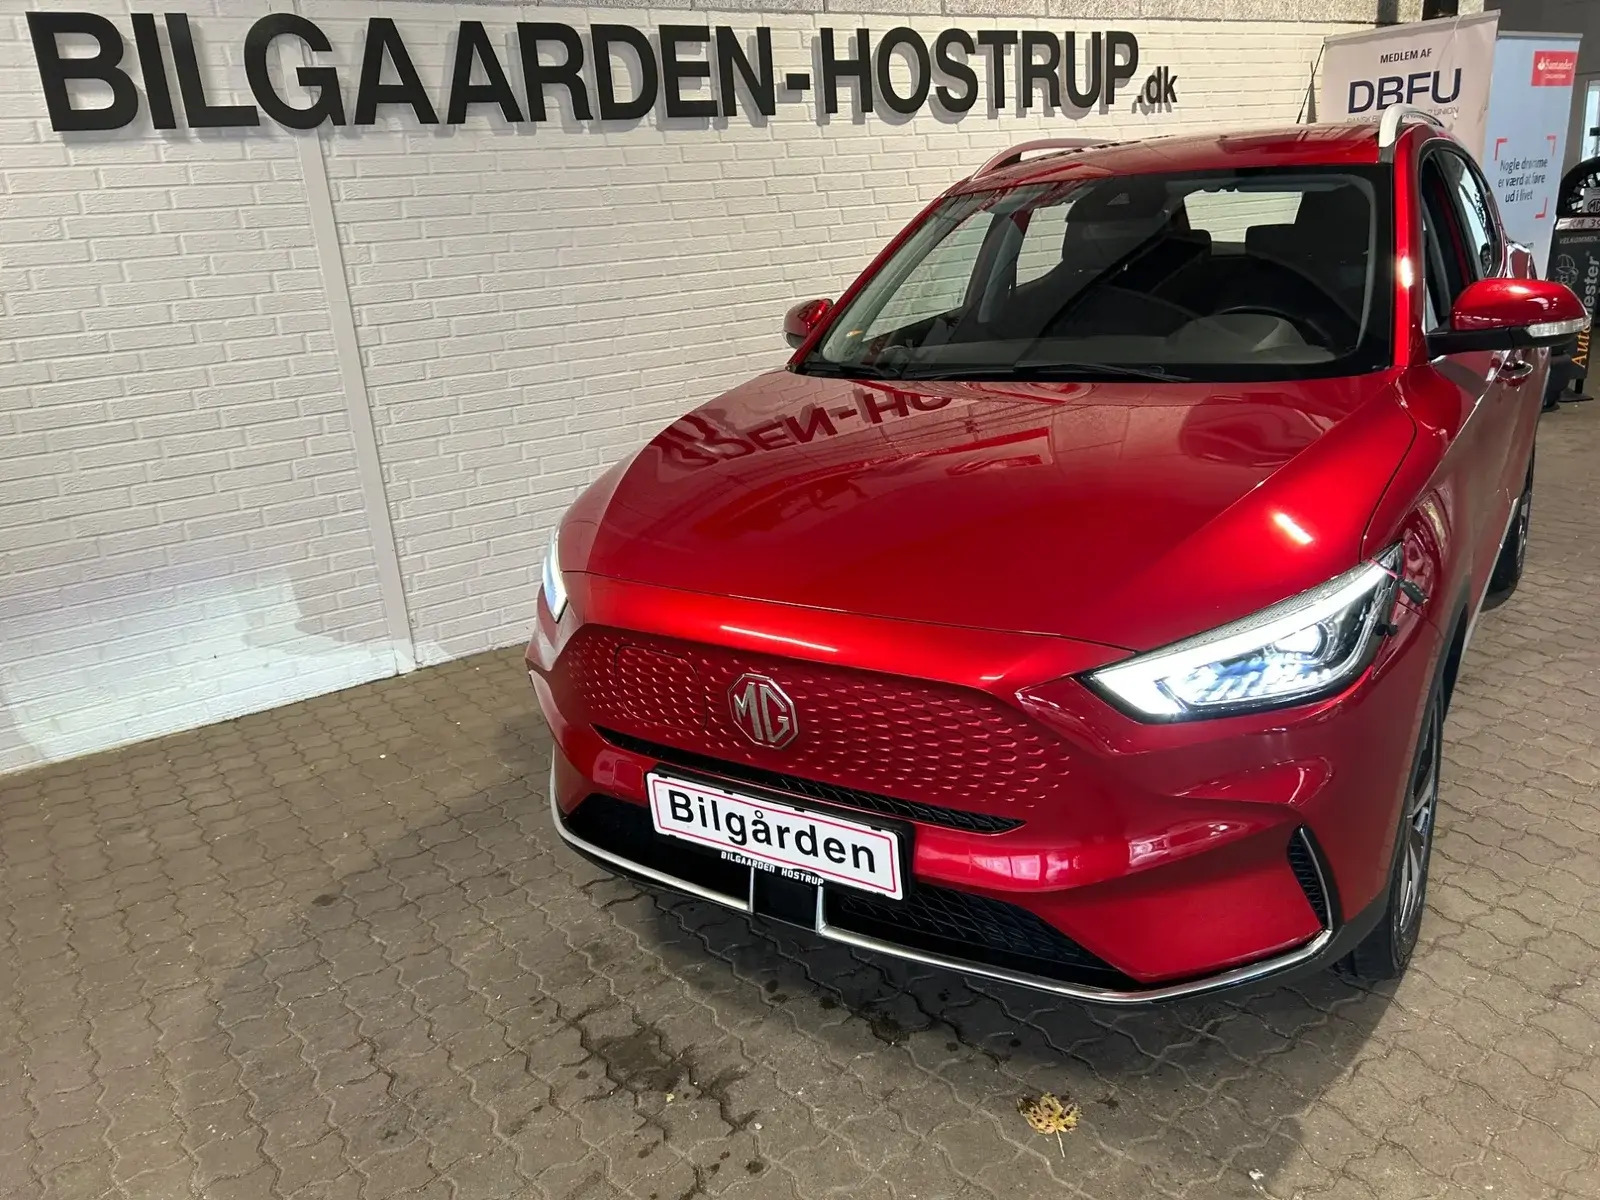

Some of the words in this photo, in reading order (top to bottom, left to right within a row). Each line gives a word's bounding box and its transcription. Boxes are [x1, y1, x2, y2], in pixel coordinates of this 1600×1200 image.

[1379, 51, 1418, 64] MEDLEM
[1420, 48, 1432, 59] AF
[1348, 68, 1462, 113] DBFU
[1498, 178, 1505, 187] er
[1506, 173, 1524, 187] værd
[1500, 158, 1520, 174] Nogle
[1505, 190, 1515, 203] ud
[1571, 256, 1600, 369] Autoester
[732, 681, 791, 743] MG
[668, 789, 876, 874] Bilgården
[721, 851, 775, 873] BILGAARDEN
[781, 868, 824, 886] HOSTRUP
